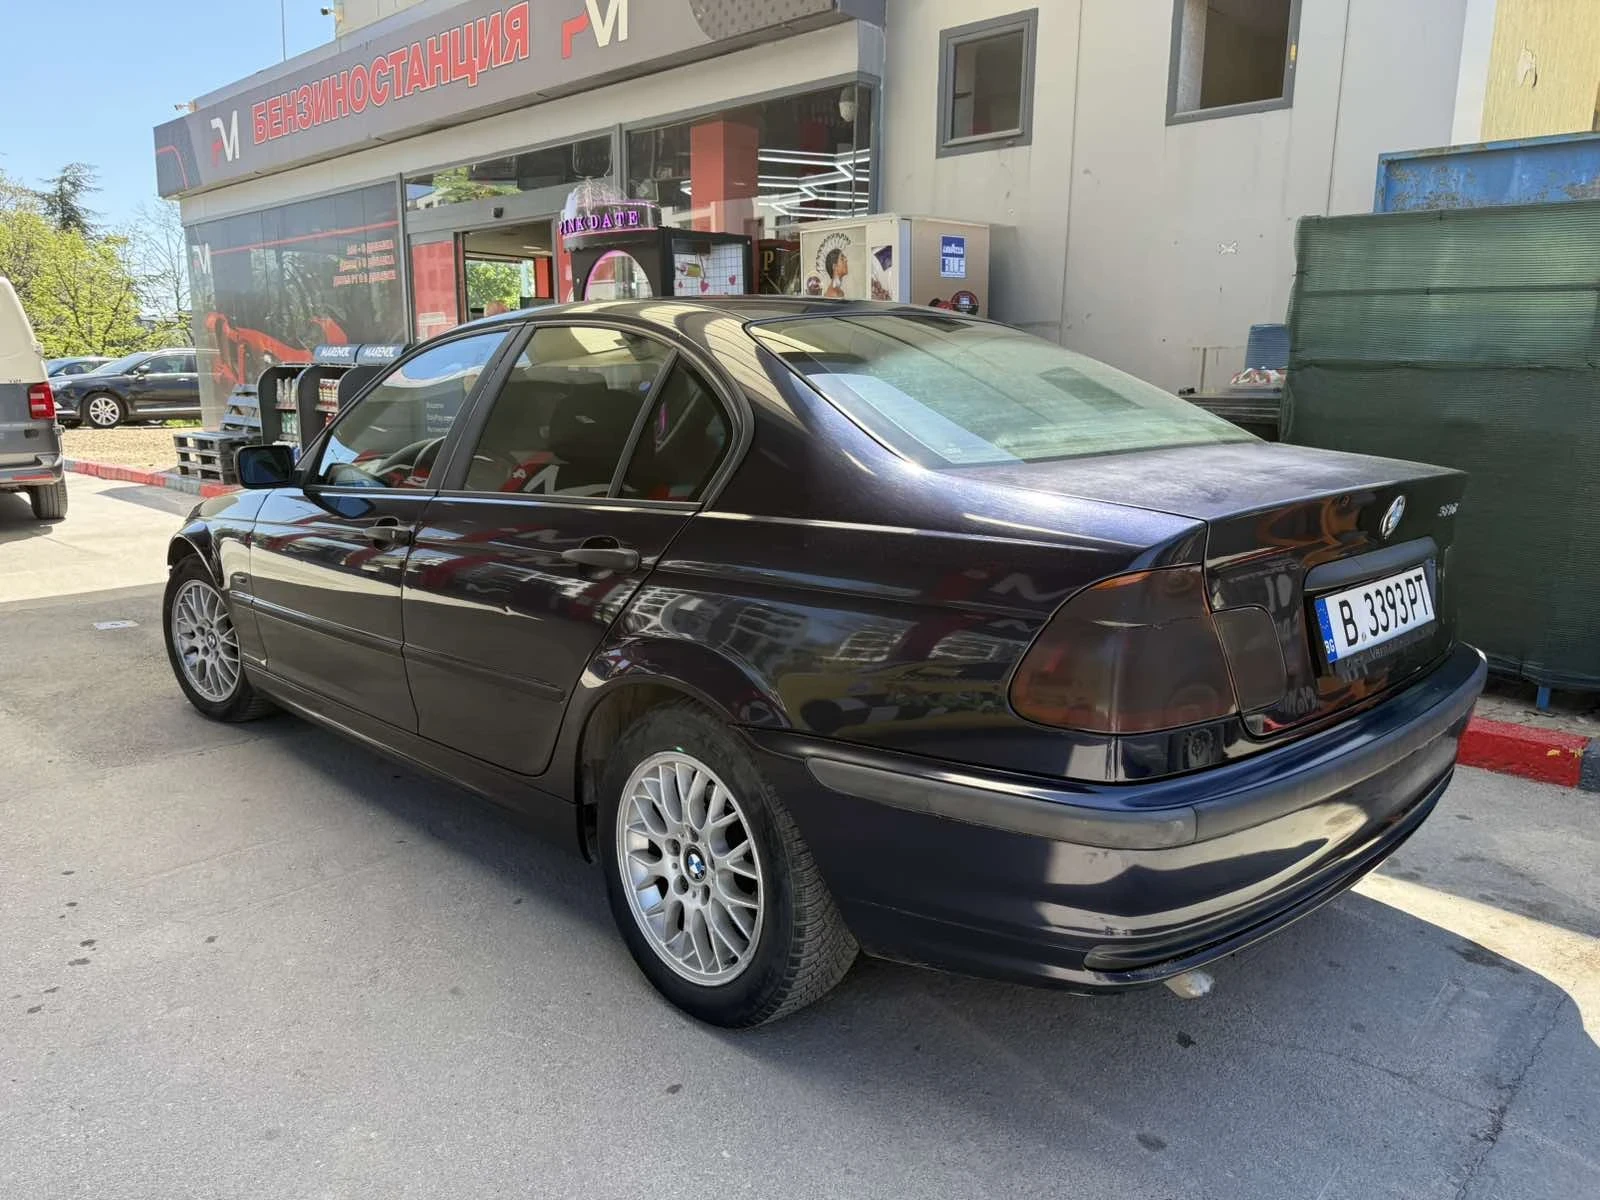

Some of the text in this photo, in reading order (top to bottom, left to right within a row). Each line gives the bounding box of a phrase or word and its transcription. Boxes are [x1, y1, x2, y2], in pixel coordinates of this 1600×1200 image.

[252, 1, 529, 145] БЕНЗИНОСТАНЦИЯ
[589, 211, 639, 229] DATE
[1324, 638, 1336, 654] BG
